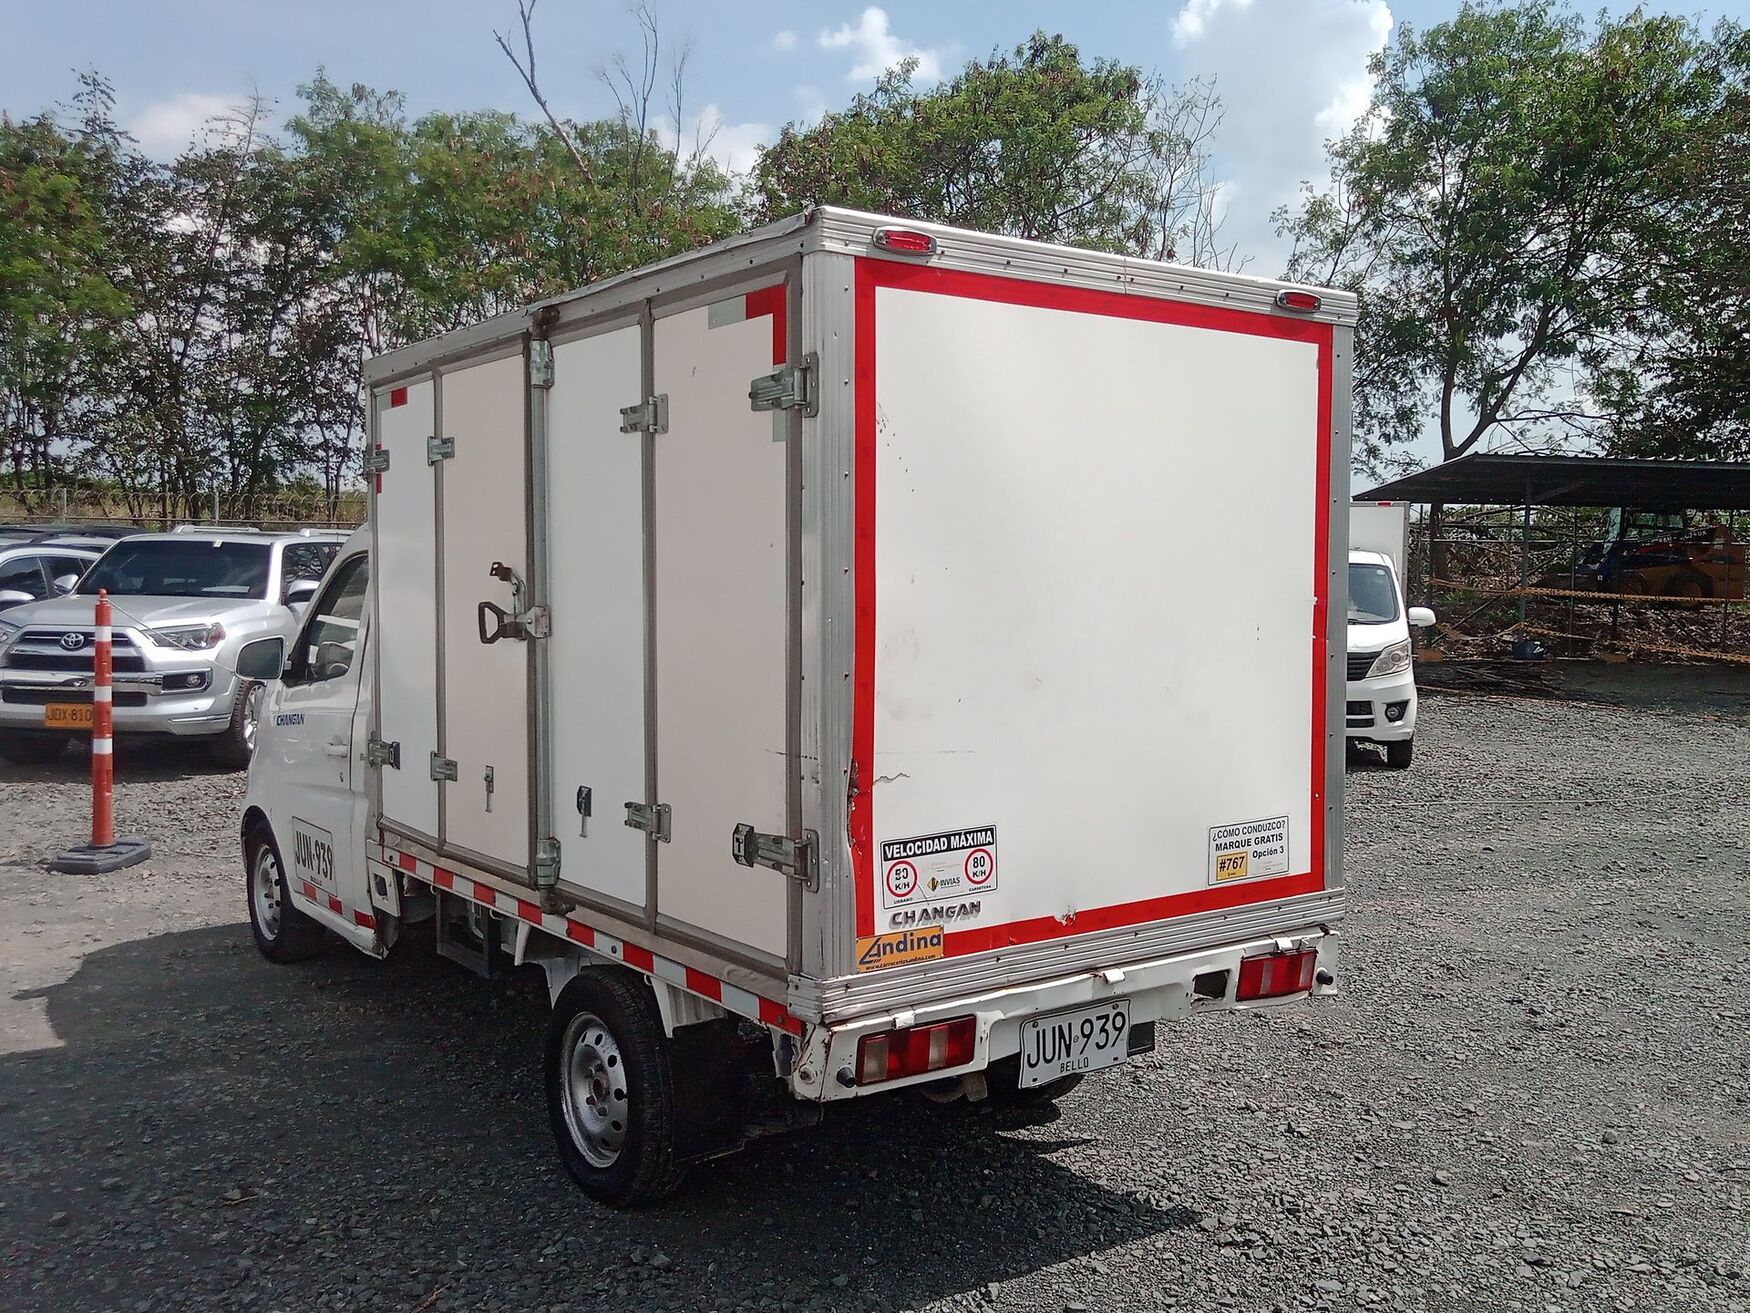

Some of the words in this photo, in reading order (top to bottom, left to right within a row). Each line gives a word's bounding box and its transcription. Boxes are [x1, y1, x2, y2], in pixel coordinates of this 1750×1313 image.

[276, 713, 305, 726] CHANGAN
[1212, 828, 1241, 842] ¿CÓMO
[1241, 820, 1286, 836] CONDUZCO?
[884, 839, 949, 860] VELOCIDAD
[950, 830, 994, 850] MÁXIMA
[1215, 838, 1252, 852] MARQUE
[1253, 832, 1284, 846] GRATIS
[1252, 847, 1278, 859] Opción
[1279, 845, 1285, 854] 3
[972, 856, 986, 868] 80
[1219, 856, 1245, 873] #767
[895, 867, 909, 881] 50
[972, 869, 987, 878] K/H
[894, 882, 910, 891] K/H
[890, 901, 981, 926] CHANGAN
[858, 931, 942, 966] Andina
[1060, 1056, 1089, 1073] BELLO
